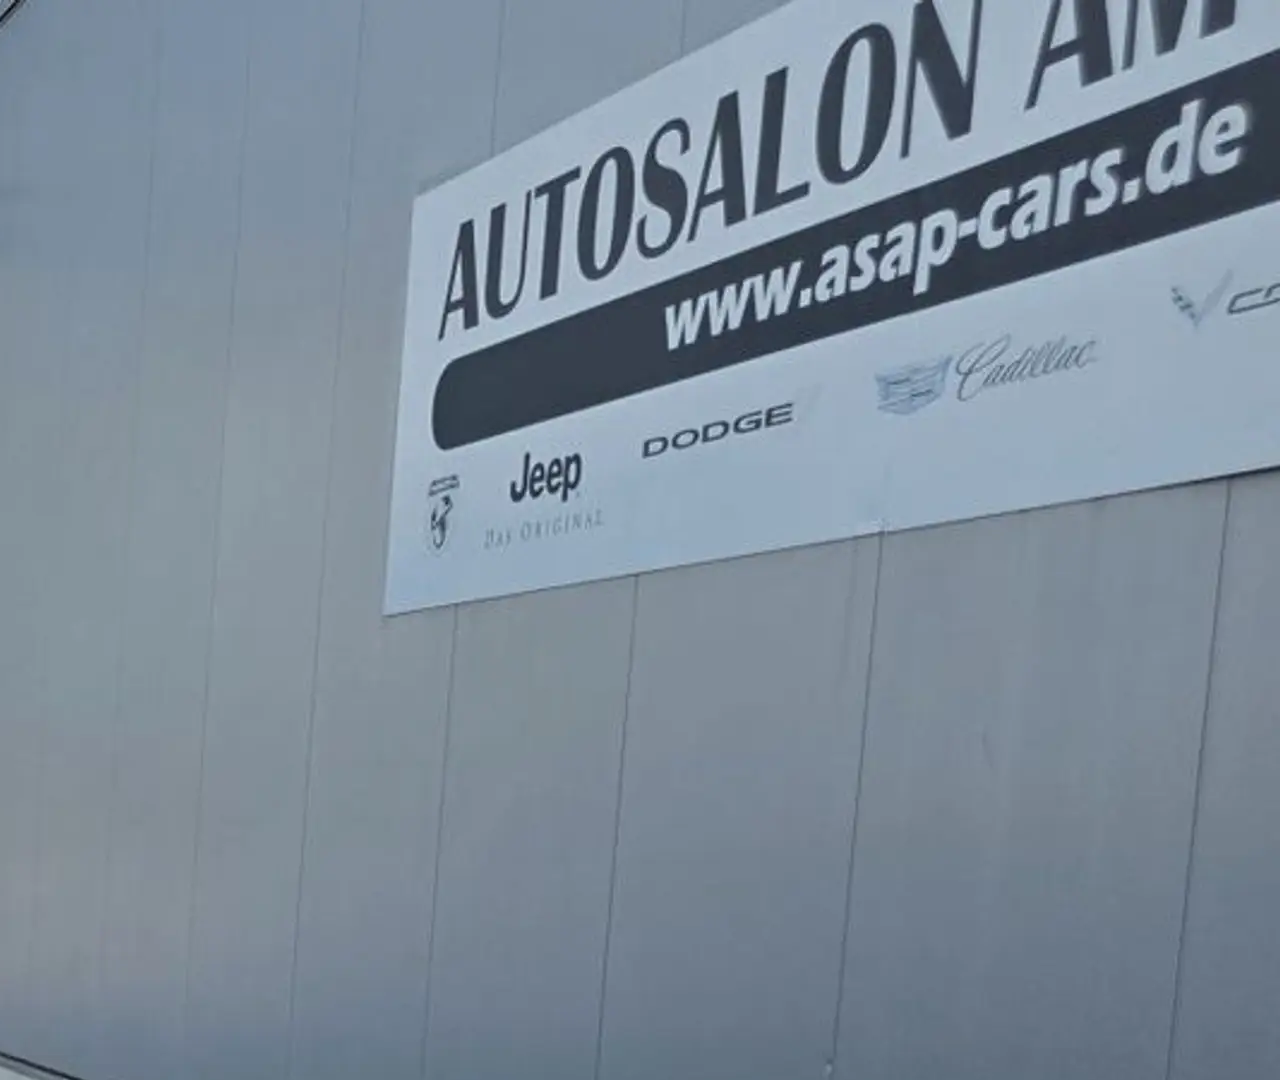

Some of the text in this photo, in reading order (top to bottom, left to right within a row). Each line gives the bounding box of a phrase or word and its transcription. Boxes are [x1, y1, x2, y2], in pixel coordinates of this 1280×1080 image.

[439, 0, 982, 341] AUTOSALON
[665, 99, 1249, 351] www.asap-cars.de
[955, 333, 1100, 402] Cadillac
[642, 402, 794, 458] DODGE
[510, 452, 582, 502] Jeep
